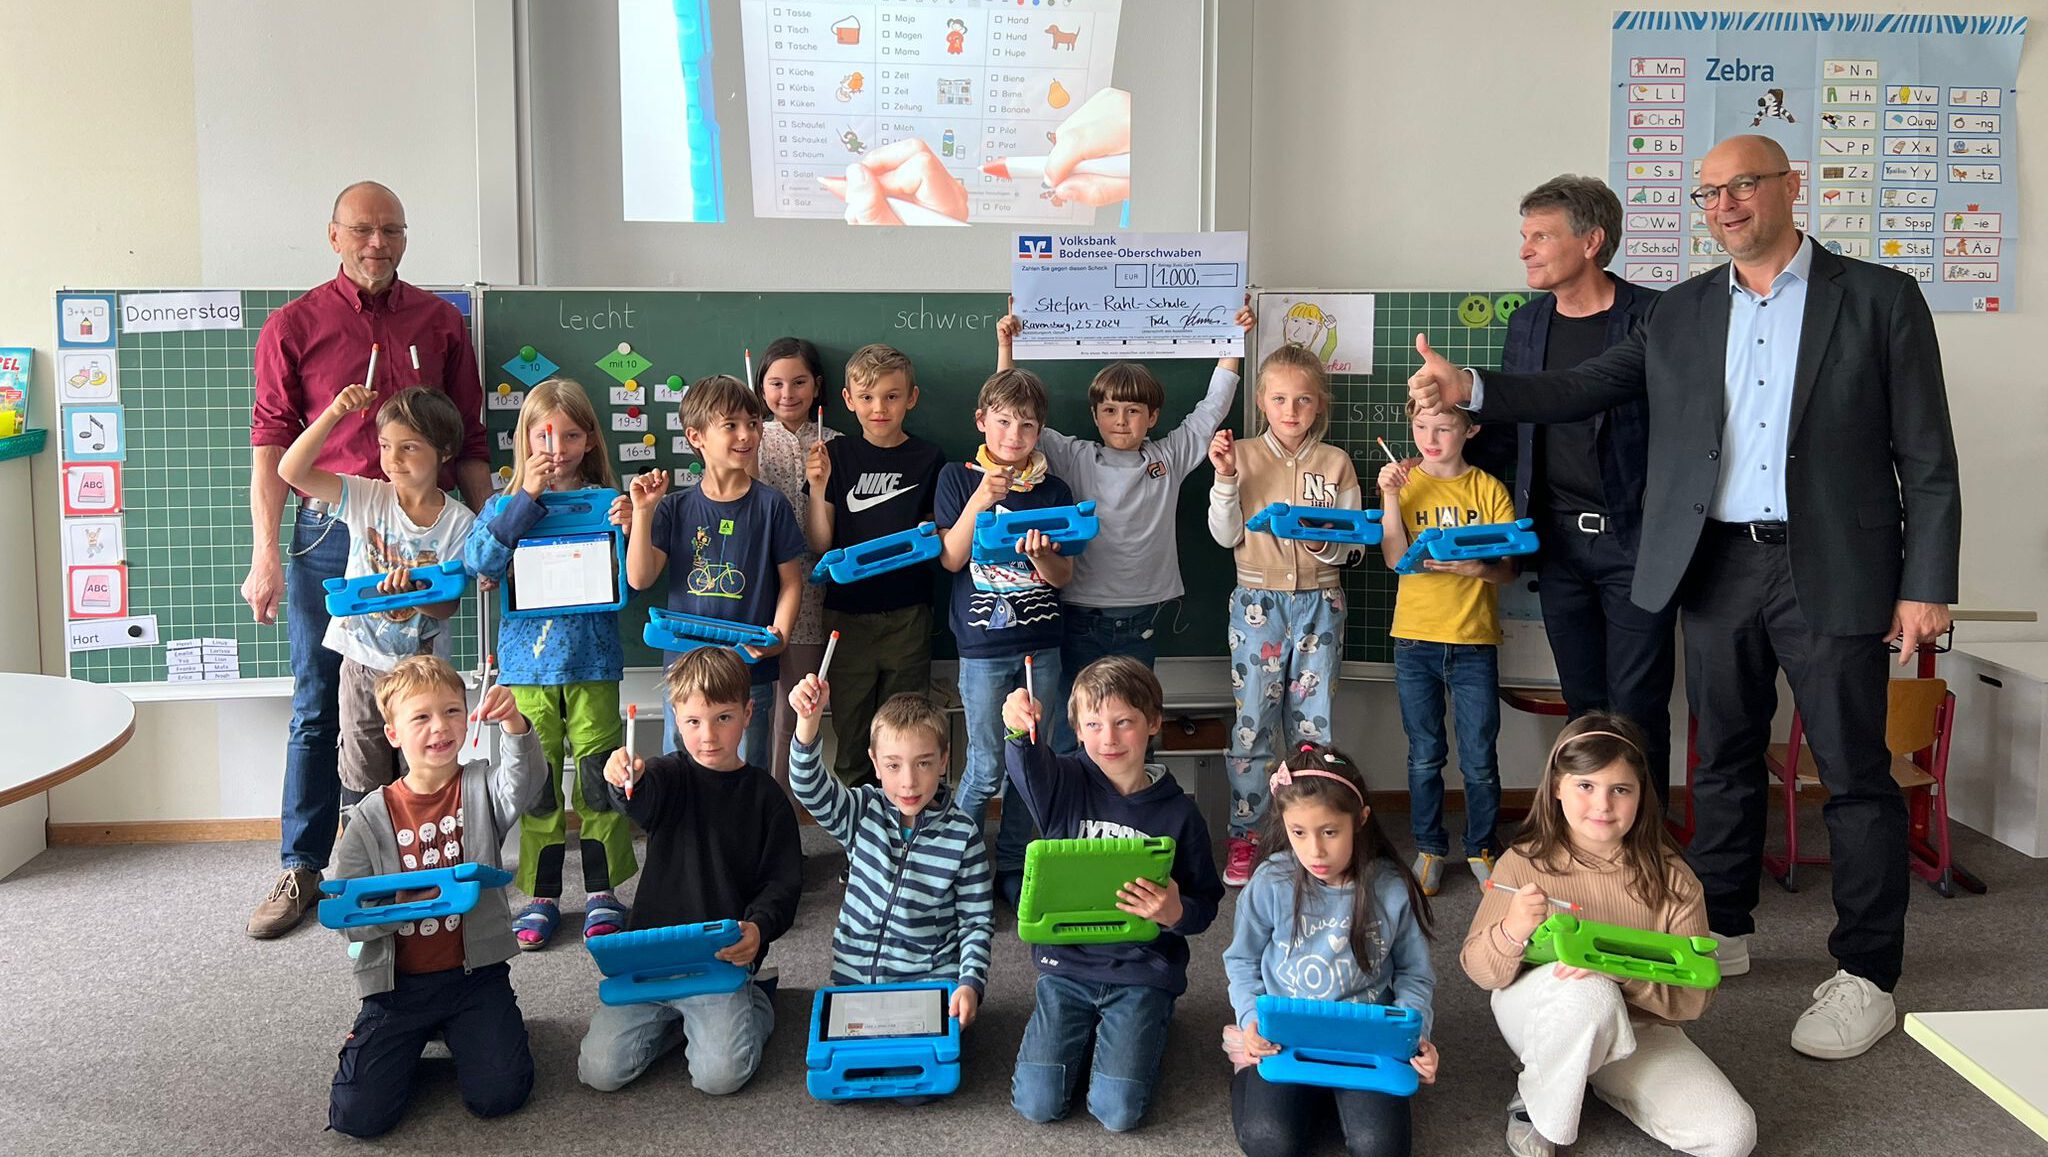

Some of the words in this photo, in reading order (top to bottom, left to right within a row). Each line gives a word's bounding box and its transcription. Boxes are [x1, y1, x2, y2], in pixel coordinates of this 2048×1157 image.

[786, 9, 811, 18] Tasse
[895, 15, 916, 24] Maja
[1007, 16, 1029, 24] Hand
[787, 26, 809, 34] Tisch
[1006, 33, 1027, 41] Hund
[788, 42, 818, 51] Tasche
[894, 48, 920, 56] Mama
[1005, 50, 1026, 58] Hupe
[788, 68, 814, 77] Küche
[1705, 58, 1774, 82] Zebra
[1003, 74, 1025, 83] Biene
[789, 84, 816, 92] Kürbis
[790, 99, 816, 108] Küken
[894, 103, 923, 114] Zeitung
[1001, 106, 1031, 114] Banane
[791, 120, 826, 130] Schaufel
[894, 124, 914, 132] Milch
[1975, 120, 1994, 133] -ng
[1000, 126, 1017, 135] Pilot
[792, 136, 828, 144] Schaukel
[998, 142, 1017, 150] Pirat
[1976, 144, 1993, 155] -ck
[792, 150, 824, 159] Schaum
[793, 170, 814, 178] Salat
[1976, 169, 1994, 181] -tz
[994, 204, 1012, 212] Foto
[1974, 218, 1990, 229] -ie
[1059, 236, 1116, 246] Volksbank
[1641, 242, 1660, 254] Sch
[1662, 242, 1678, 254] sch
[1059, 248, 1202, 258] Bodensee-Oberschwaben
[1972, 270, 1992, 280] -au
[126, 303, 241, 322] Donnerstag
[560, 298, 636, 331] leicht
[529, 363, 541, 372] 10
[609, 360, 624, 369] mit
[626, 360, 637, 368] 10
[616, 390, 640, 402] 12-2
[494, 396, 520, 406] 10-8
[618, 417, 642, 428] 19-9
[626, 447, 651, 458] 16-6
[82, 481, 103, 489] ABC
[854, 472, 903, 494] NIKE
[87, 584, 108, 592] ABC
[72, 634, 100, 645] Hort
